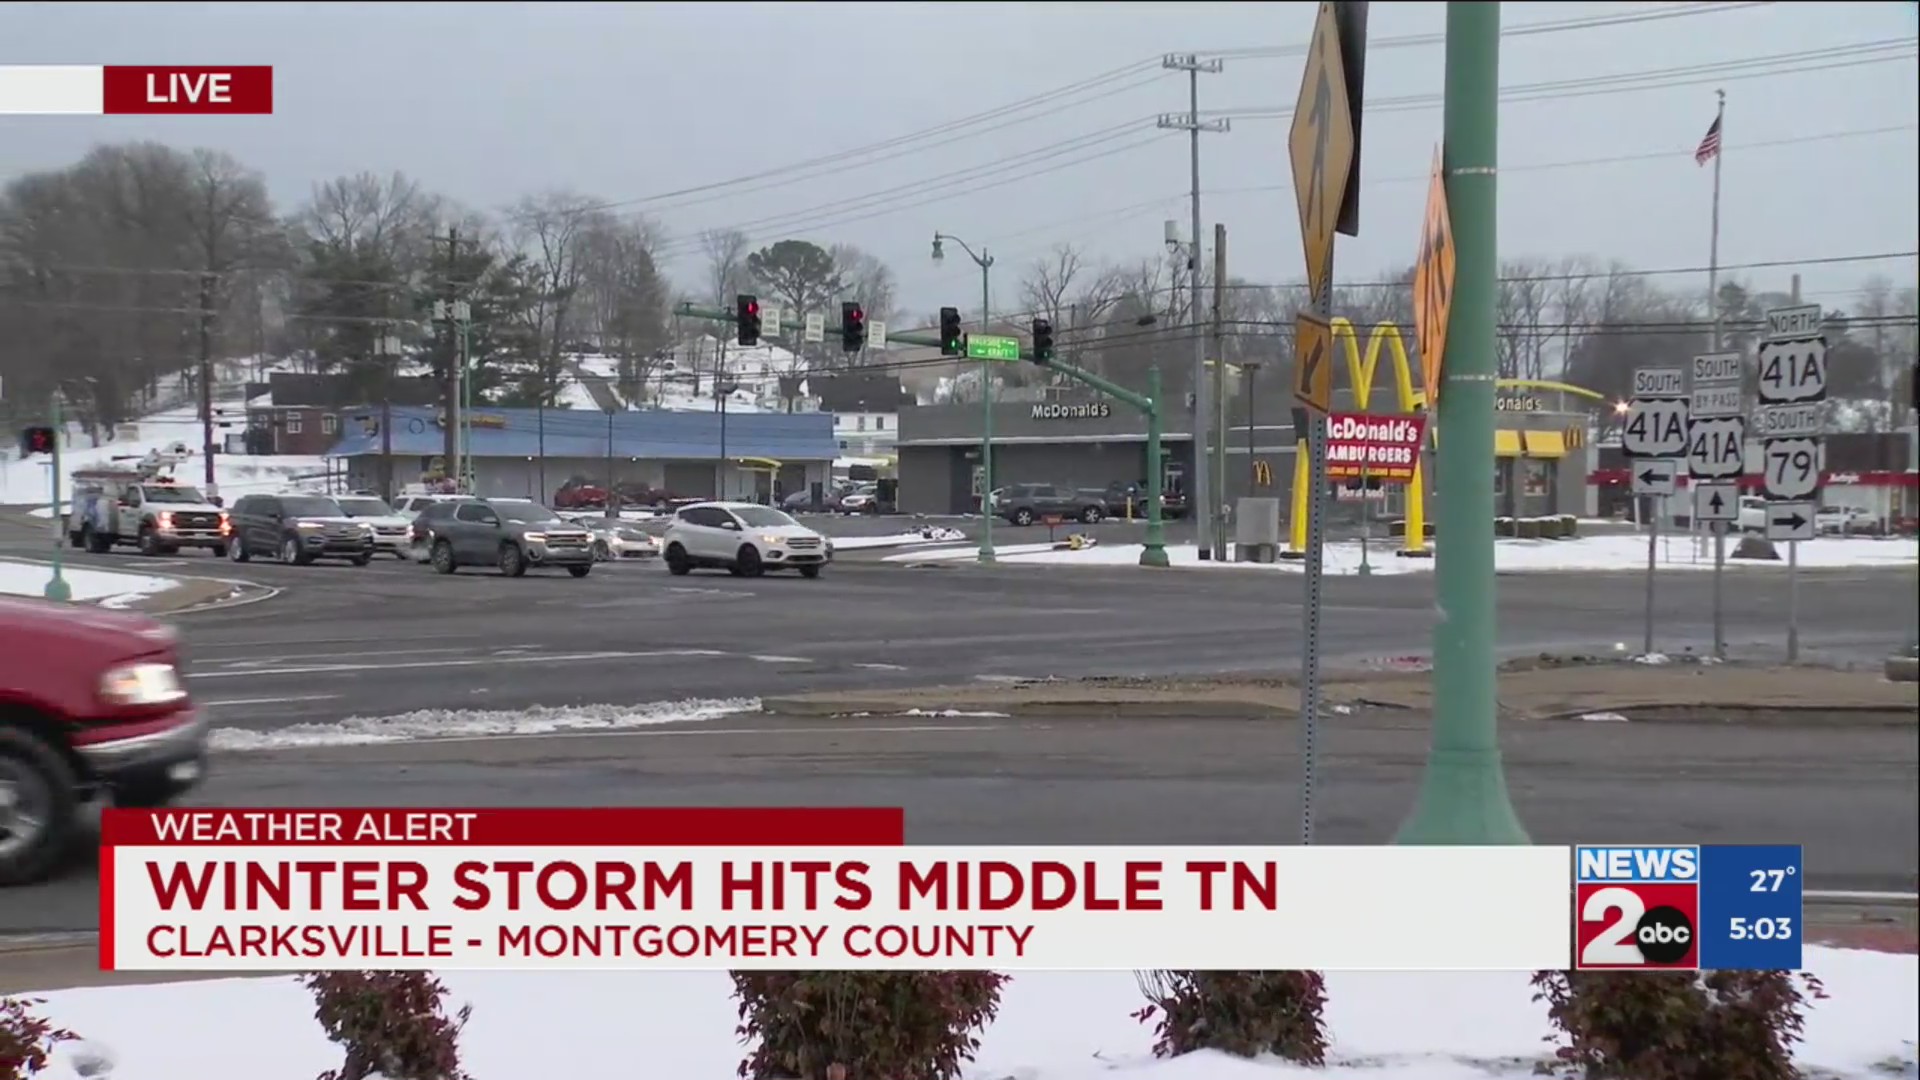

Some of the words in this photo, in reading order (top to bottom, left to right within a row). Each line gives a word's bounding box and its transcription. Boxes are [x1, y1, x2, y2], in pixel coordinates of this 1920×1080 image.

[1769, 311, 1819, 333] NORTH
[1695, 358, 1739, 379] SOUTH
[1762, 352, 1822, 389] 41A
[1636, 371, 1682, 393] SOUTH
[1032, 403, 1109, 418] McDonald's
[1768, 410, 1816, 432] SOUTH
[1626, 411, 1684, 443] 41A
[1325, 444, 1412, 463] AMBURGERS
[1691, 431, 1740, 466] 41A
[1772, 450, 1811, 485] 79
